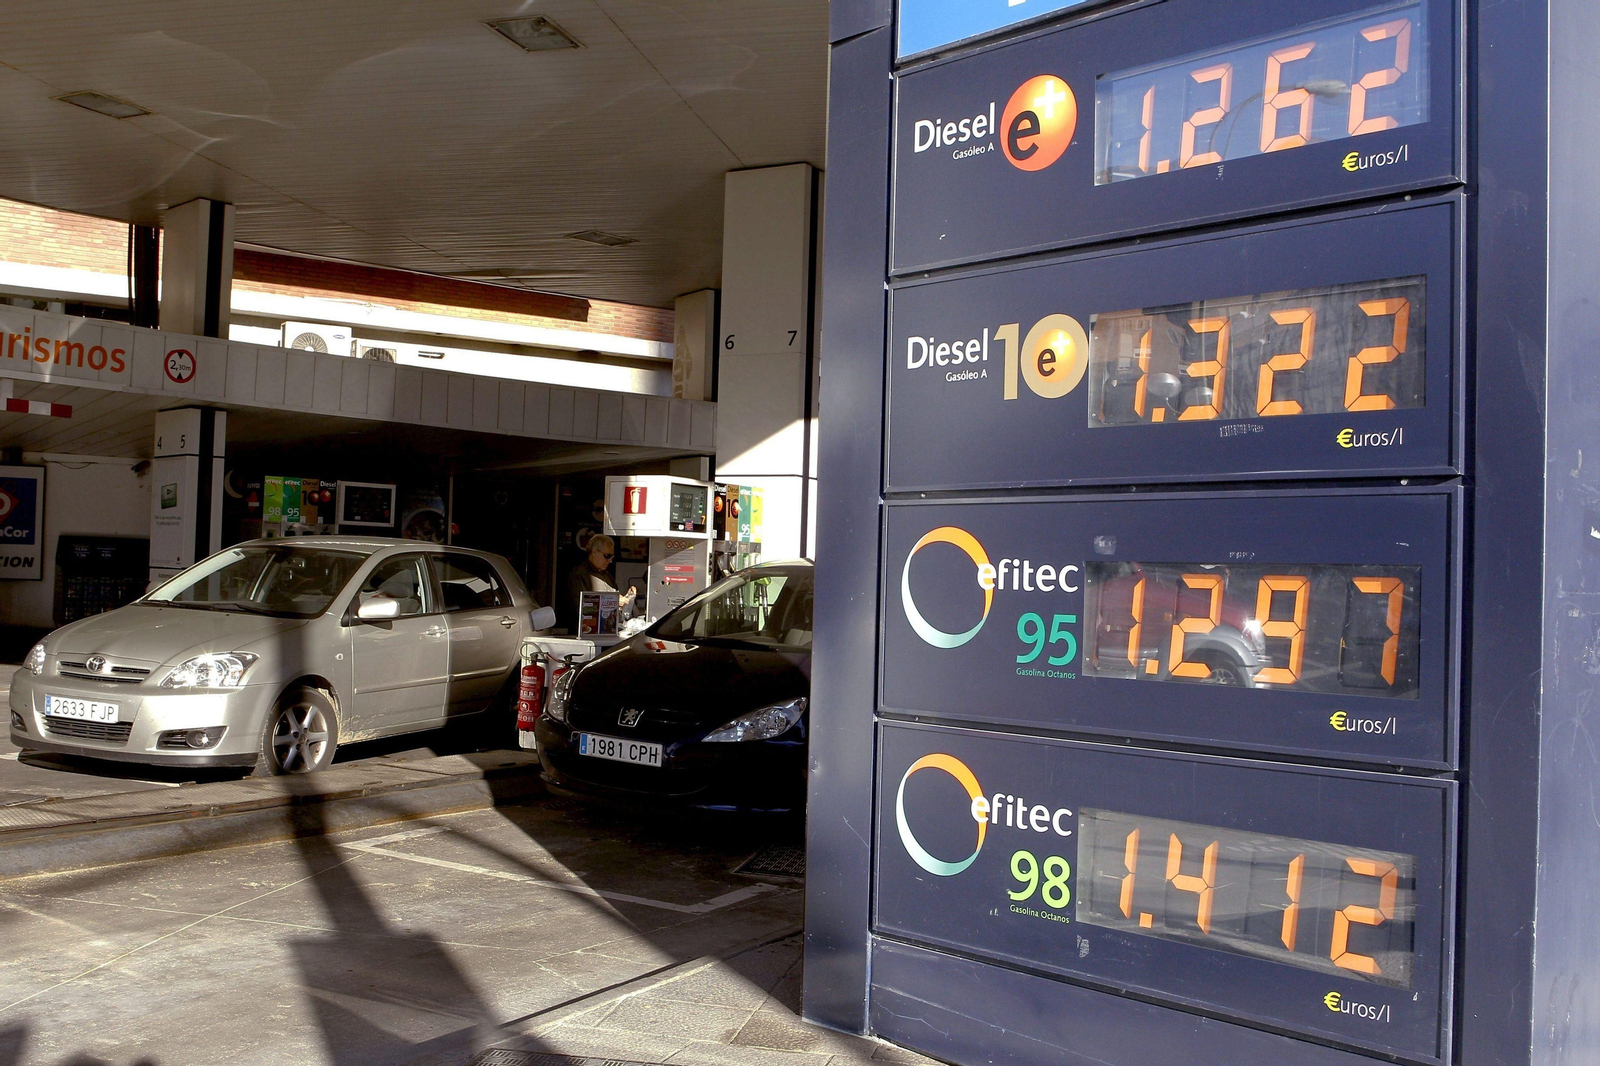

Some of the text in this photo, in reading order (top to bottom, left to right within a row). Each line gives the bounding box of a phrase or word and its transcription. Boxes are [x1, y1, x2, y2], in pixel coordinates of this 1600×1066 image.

[1138, 18, 1411, 174] 1.262
[914, 102, 996, 153] Diesel
[952, 142, 995, 161] Gasóleo A
[1341, 144, 1409, 172] €uros/l
[725, 334, 735, 350] 6
[787, 330, 798, 347] 7
[0, 327, 126, 373] rismos
[907, 313, 1090, 400] Diesel 10
[1134, 297, 1410, 423] 1.322
[946, 368, 988, 383] Gasóleo A
[157, 436, 162, 450] 4
[180, 434, 186, 449] 5
[1336, 427, 1403, 449] €uros/l
[320, 480, 337, 488] Diesel
[301, 490, 320, 507] 10
[726, 498, 739, 519] 10
[268, 506, 281, 516] 98
[287, 507, 300, 517] 95
[700, 514, 707, 525] 7
[741, 523, 751, 537] 95
[0, 556, 35, 568] ION
[977, 558, 1079, 593] efitec
[1016, 612, 1078, 666] 95
[1127, 573, 1404, 686] 1.297
[1016, 667, 1076, 680] Gasolina Octanos
[54, 699, 115, 721] 2633 FJP
[1329, 710, 1396, 735] €uros/l
[591, 737, 659, 764] 1981 CPH
[971, 793, 1073, 837] efitec
[1009, 849, 1072, 909] 98
[1119, 827, 1398, 975] 1.412
[1010, 904, 1070, 924] Gasolina Octanos
[1323, 991, 1390, 1023] €uros/l
